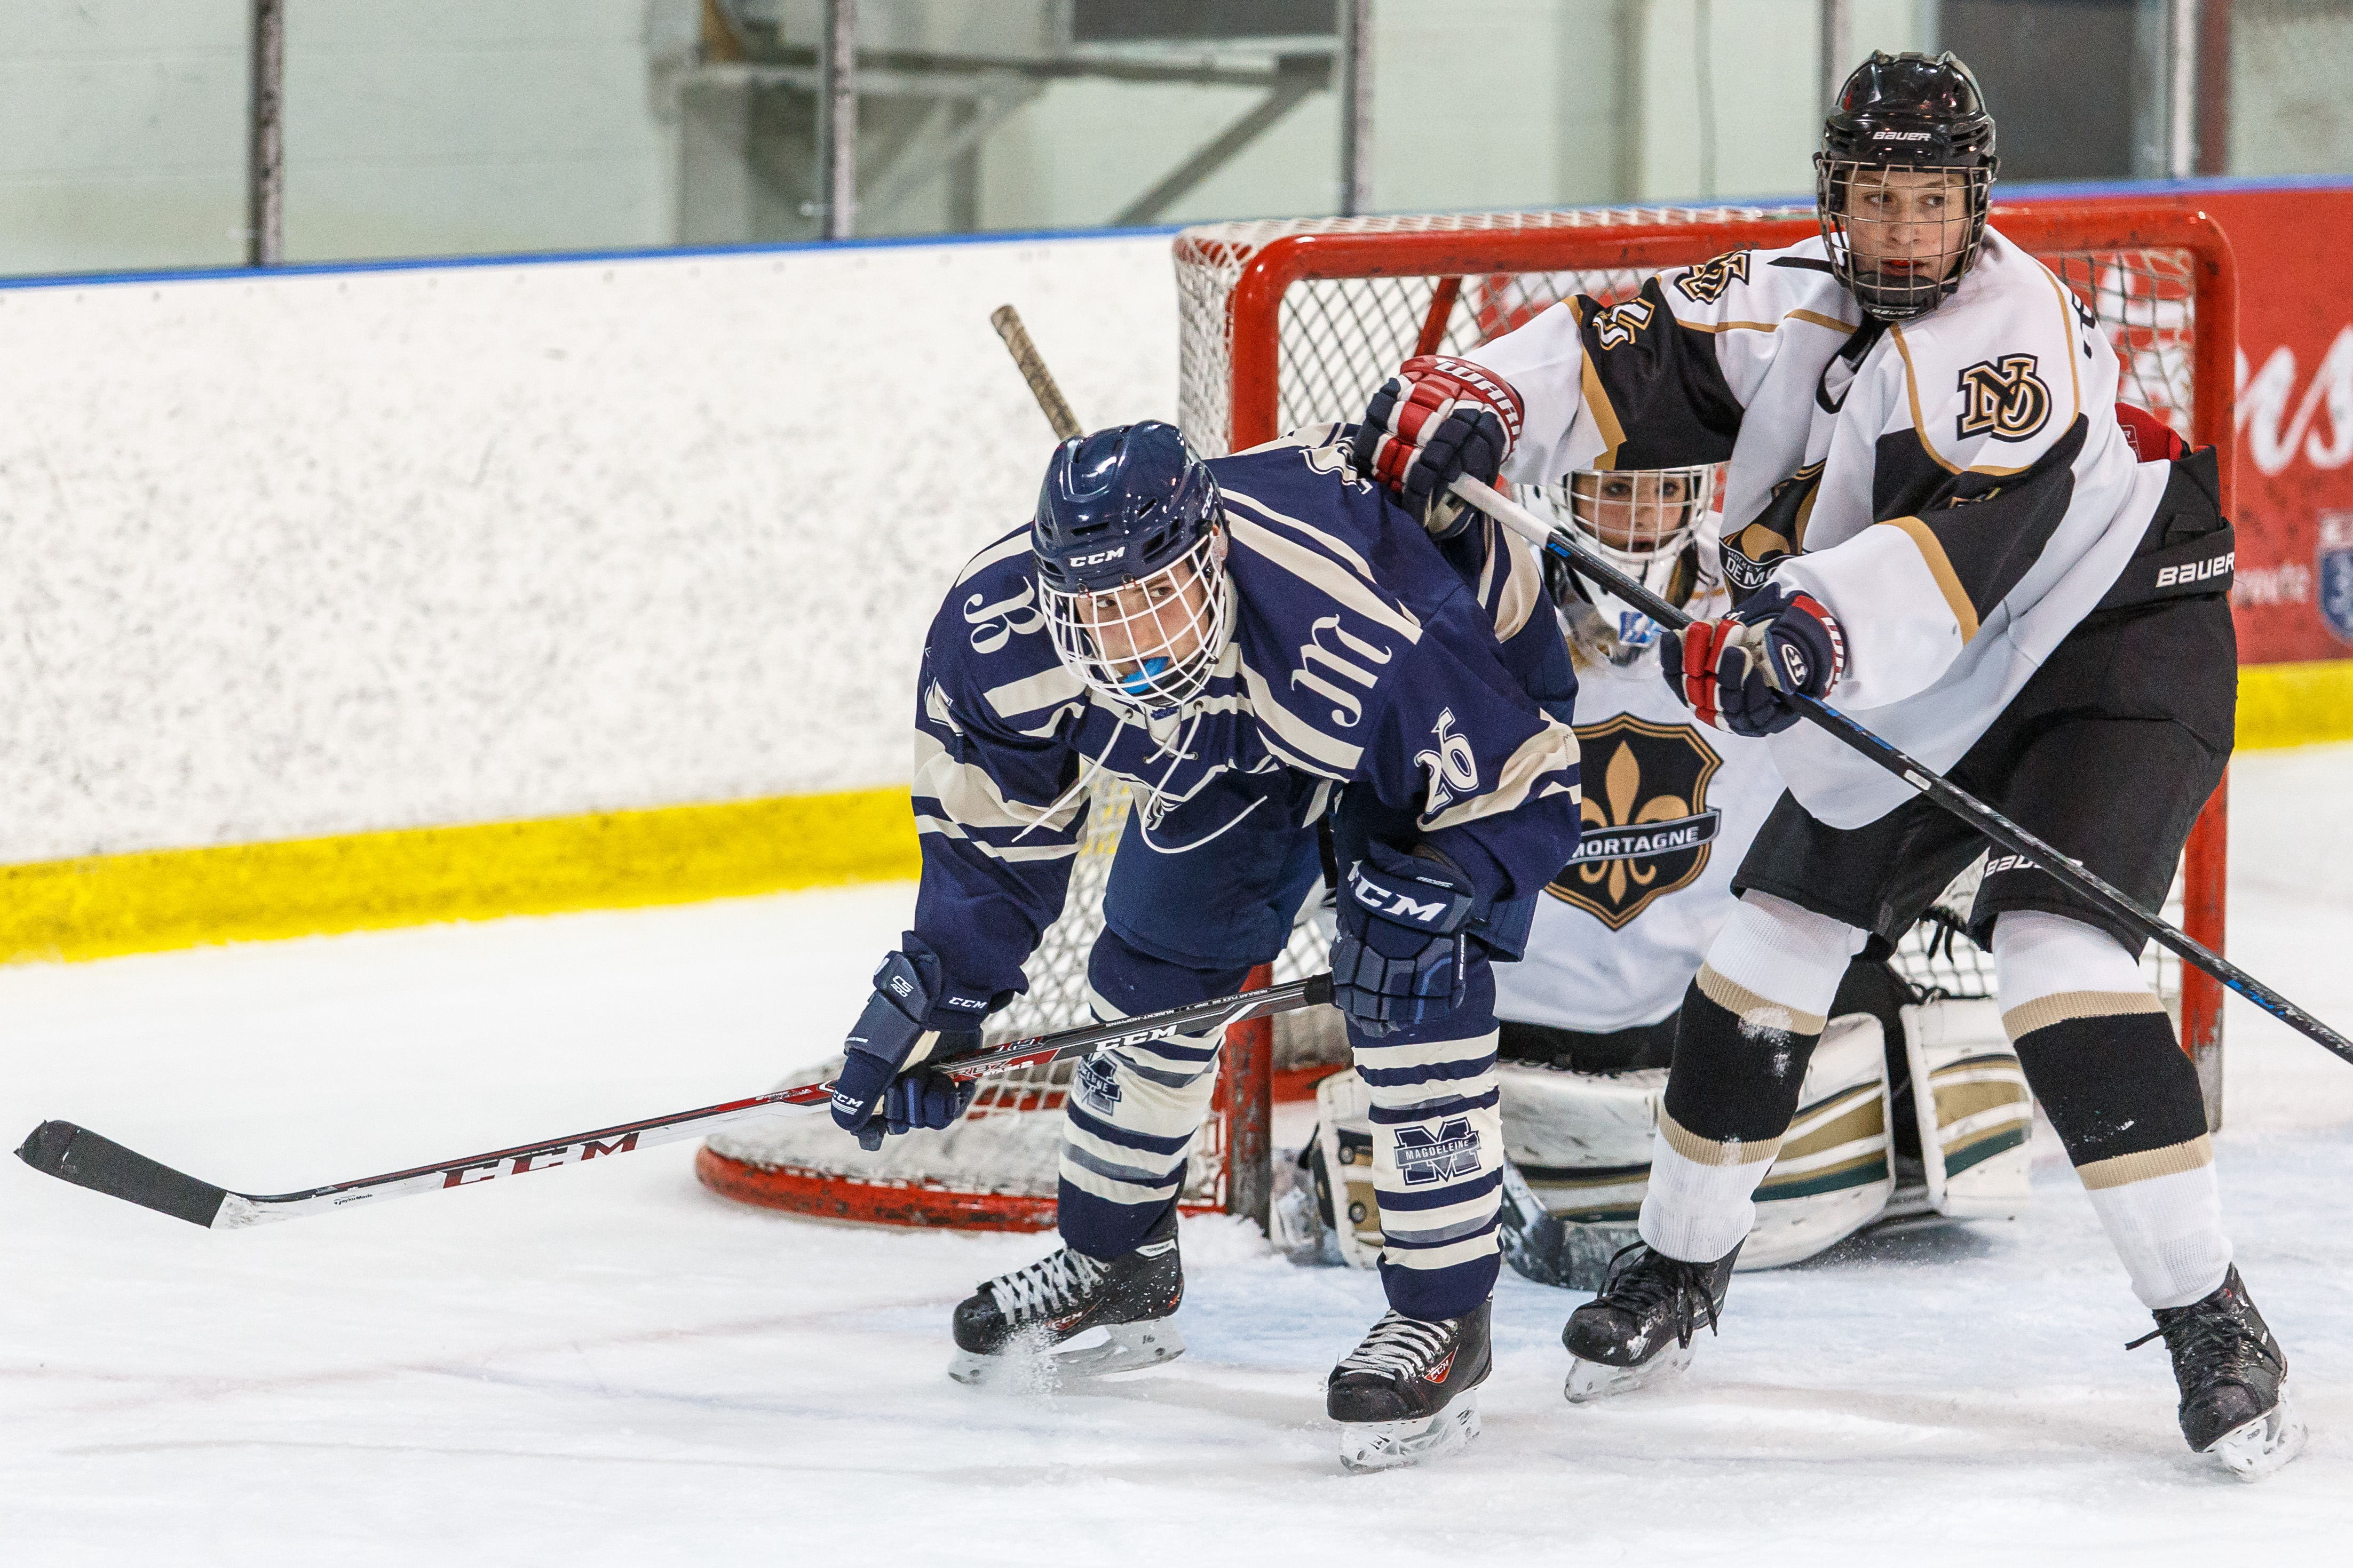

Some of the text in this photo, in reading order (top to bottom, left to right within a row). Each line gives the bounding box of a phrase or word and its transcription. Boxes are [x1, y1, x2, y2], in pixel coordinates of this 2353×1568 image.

[1873, 131, 1931, 141] BAUER
[1069, 546, 1125, 568] CCM
[1726, 556, 1744, 580] DE
[1728, 551, 1763, 572] HOCKEY
[2156, 552, 2235, 587] BAUER
[1414, 706, 1479, 814] 26
[949, 997, 988, 1009] CCM
[1095, 1024, 1177, 1052] CCM
[442, 1131, 640, 1189] CCM
[1405, 1139, 1469, 1161] MAGDELEINE
[334, 1193, 373, 1205] TaylorMade
